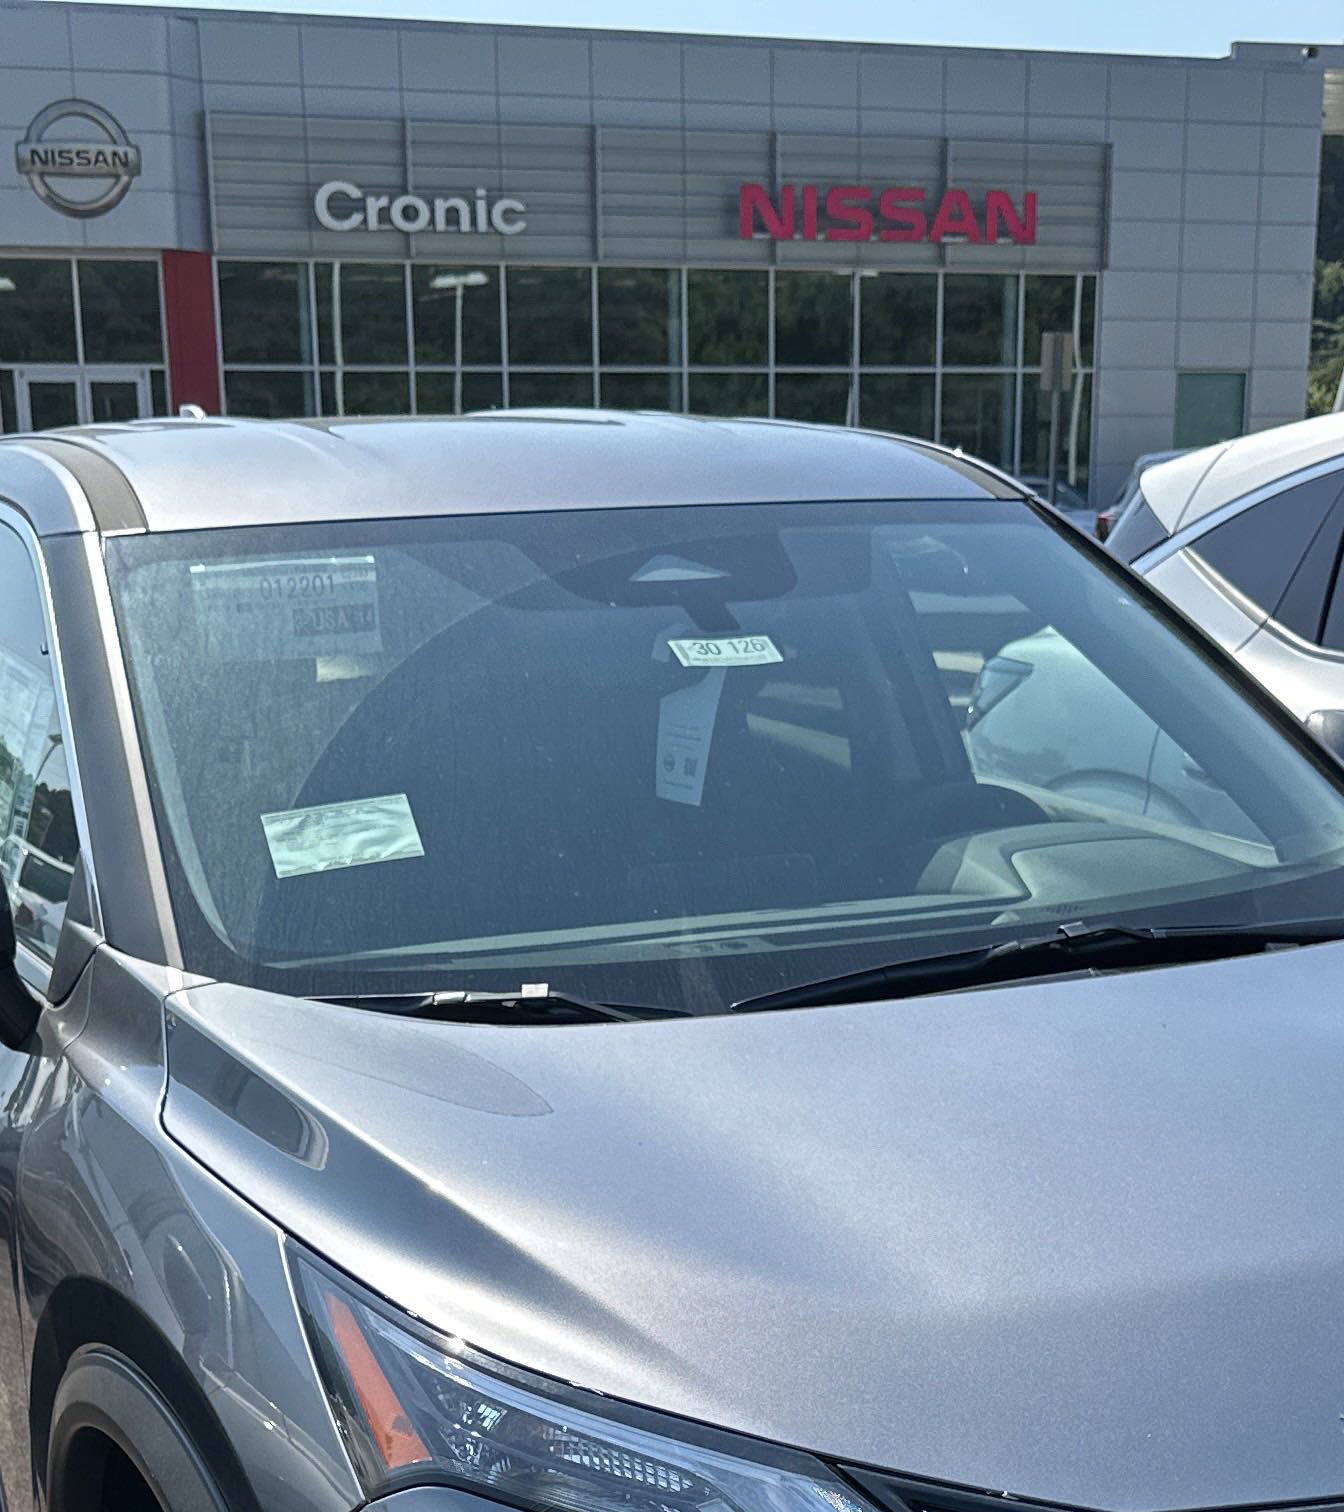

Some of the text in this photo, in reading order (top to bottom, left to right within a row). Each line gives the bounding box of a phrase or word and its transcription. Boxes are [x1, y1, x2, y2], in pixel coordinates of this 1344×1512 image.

[30, 148, 129, 168] NISSAN
[314, 180, 528, 235] Cronic
[739, 183, 1037, 245] NISSAN
